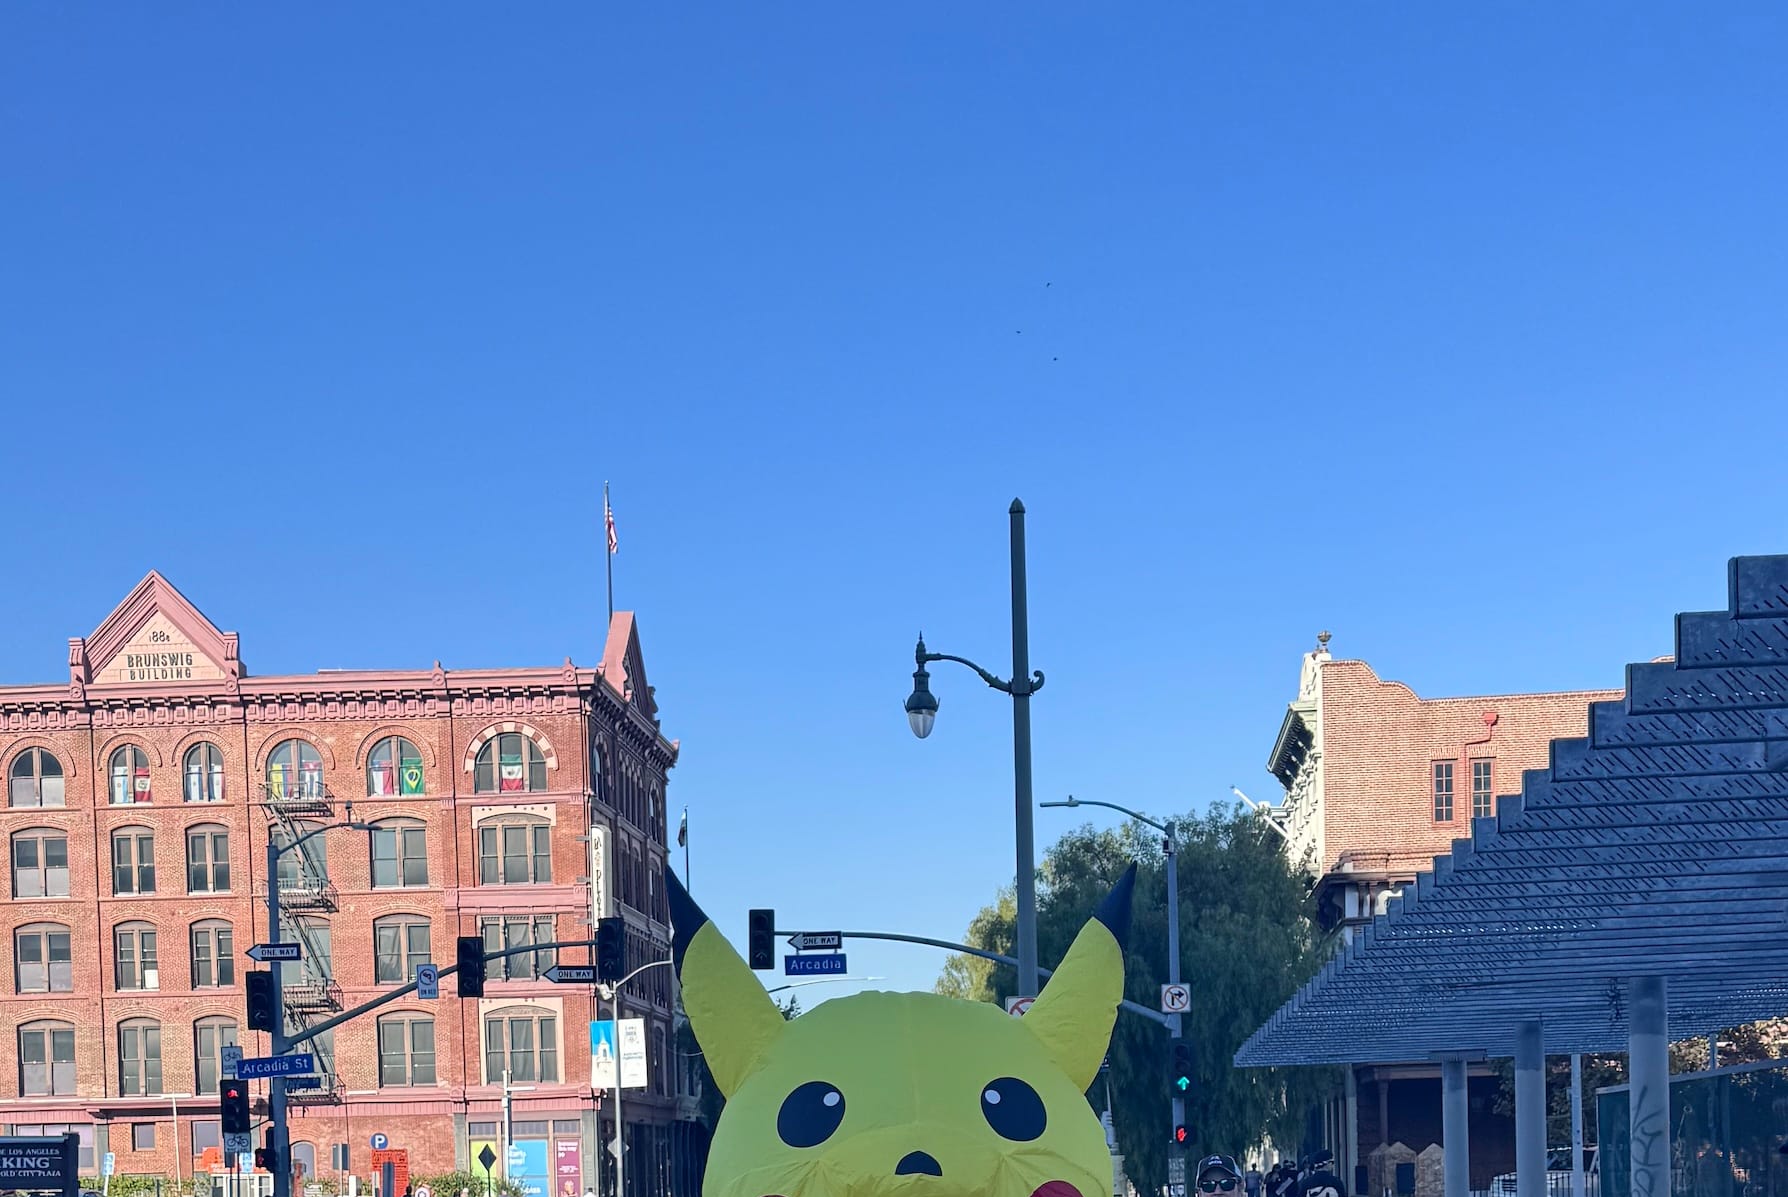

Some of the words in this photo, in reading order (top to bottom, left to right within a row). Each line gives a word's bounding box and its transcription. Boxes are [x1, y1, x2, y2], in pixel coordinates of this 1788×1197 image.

[127, 653, 193, 668] BRUNSWIG
[129, 668, 192, 681] BUILDING
[803, 937, 818, 945] ONE
[820, 937, 836, 945] WAY
[261, 948, 276, 956] ONE
[279, 948, 295, 956] WAY
[790, 959, 841, 970] Arcadia
[558, 970, 574, 978] ONE
[576, 970, 591, 978] WAY
[242, 1060, 289, 1074] Arcadia
[295, 1058, 308, 1069] St
[0, 1157, 50, 1168] KING
